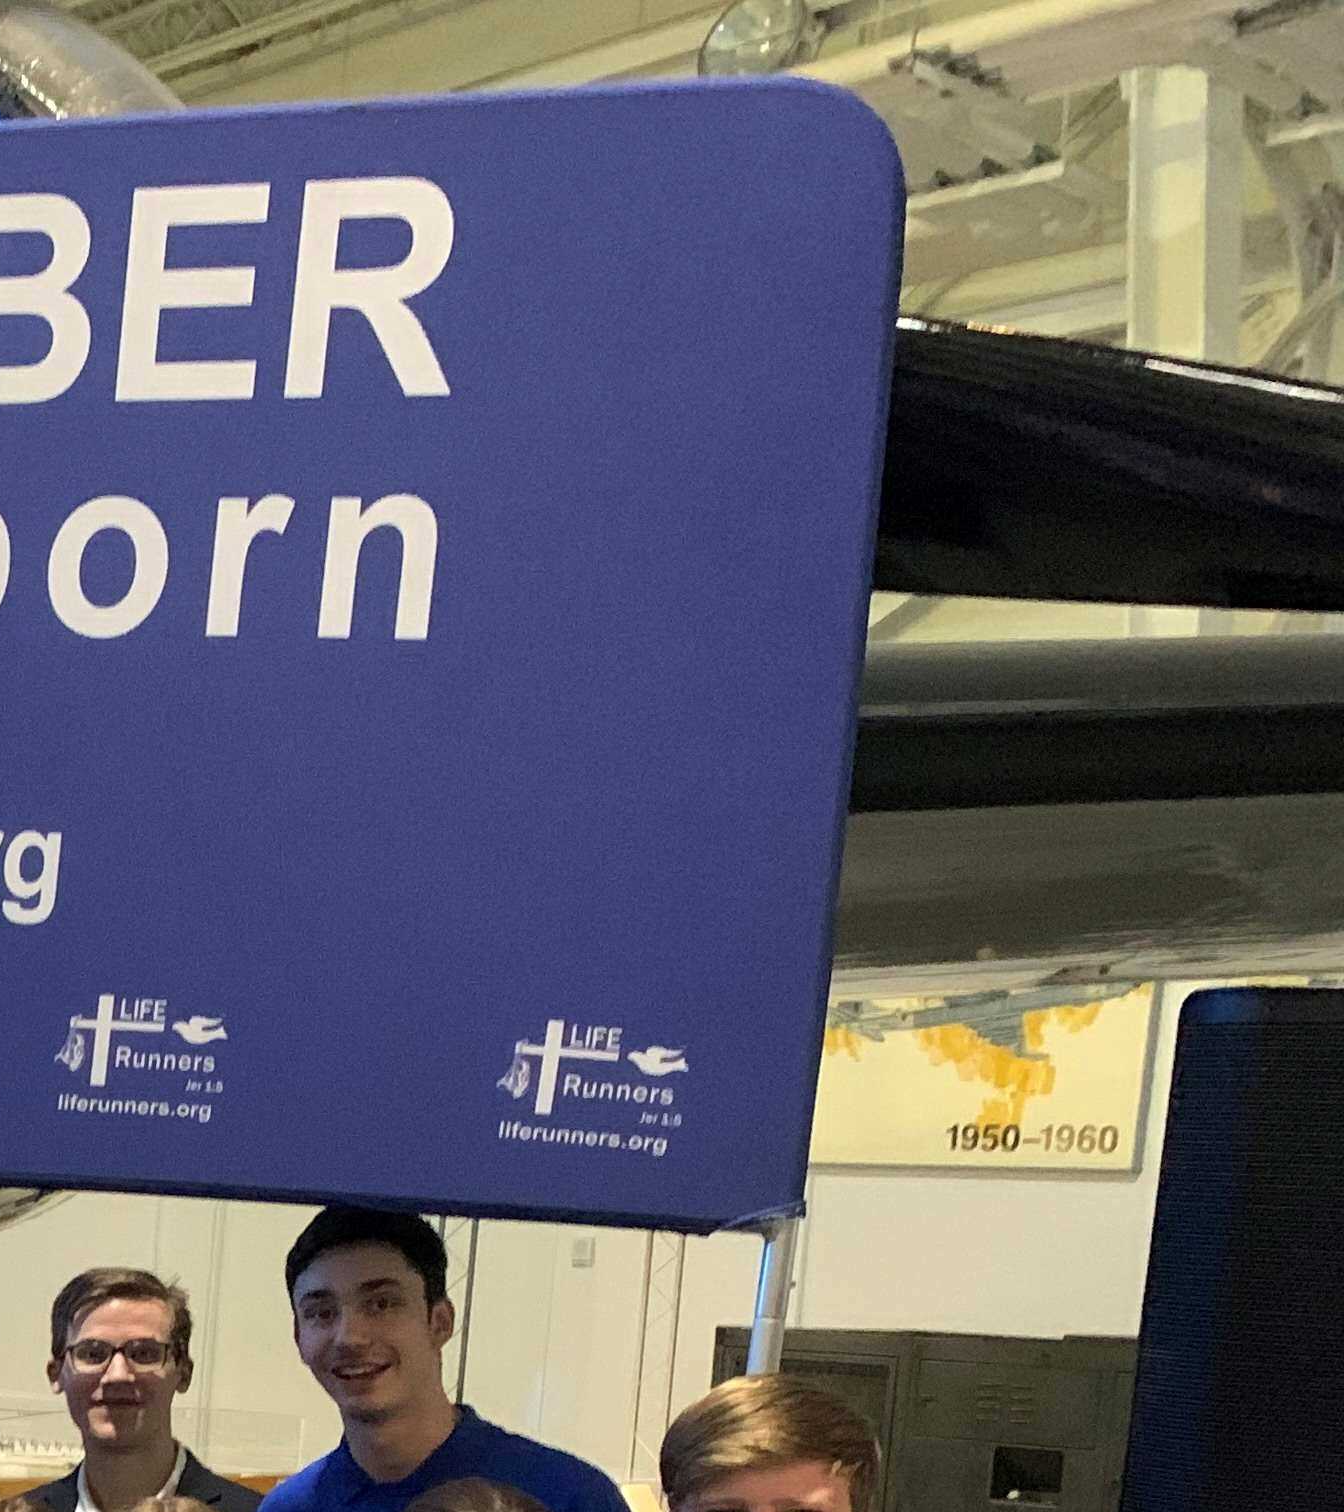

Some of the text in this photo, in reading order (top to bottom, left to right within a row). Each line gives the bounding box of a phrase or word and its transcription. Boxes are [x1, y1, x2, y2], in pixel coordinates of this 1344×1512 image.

[119, 998, 168, 1023] LIFE
[570, 1023, 623, 1050] LIFE
[115, 1045, 216, 1074] Runners
[563, 1073, 674, 1105] Runners
[57, 1093, 212, 1123] liferunners.org
[499, 1120, 668, 1157] liferunners.org
